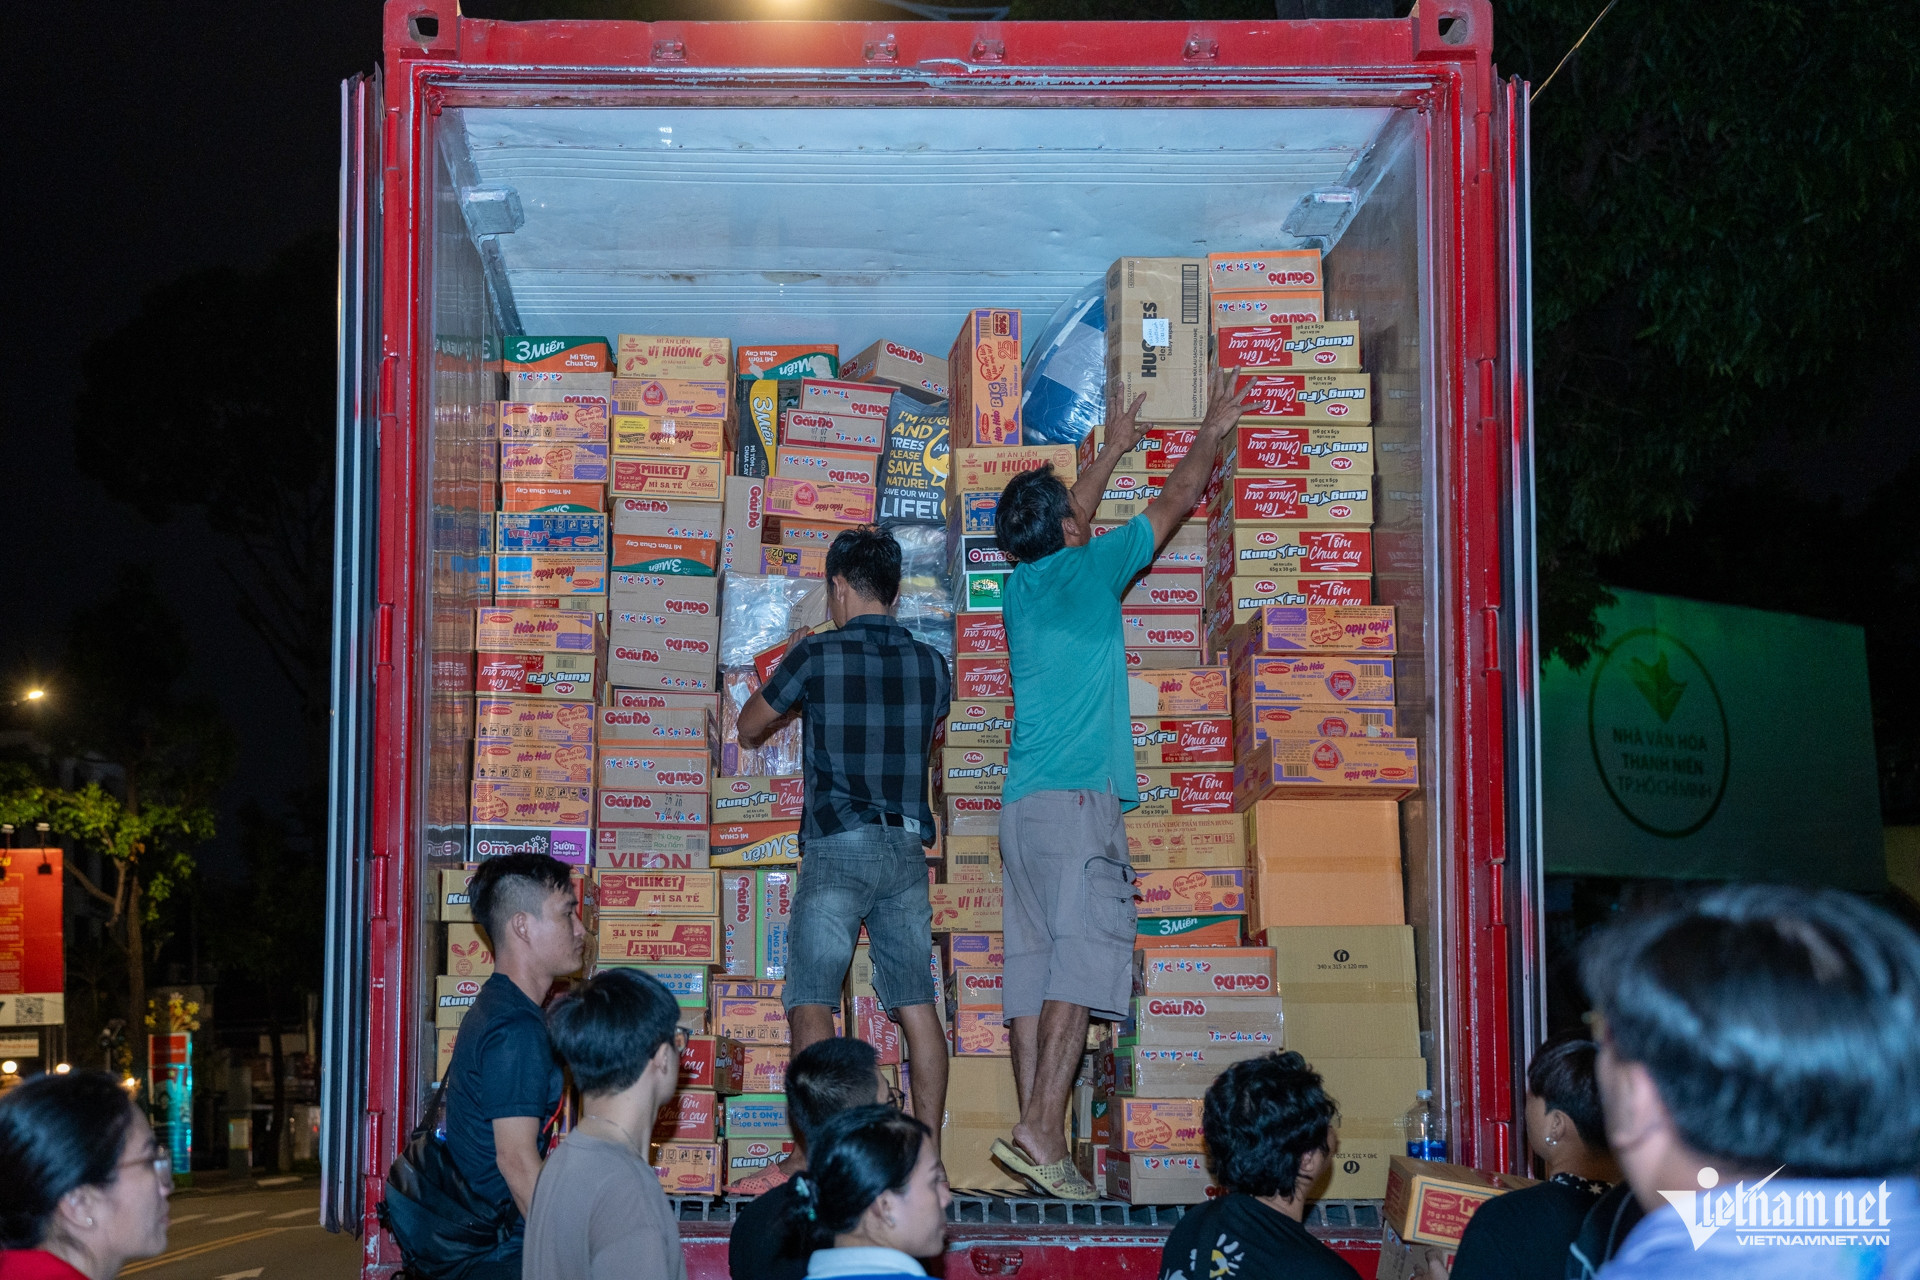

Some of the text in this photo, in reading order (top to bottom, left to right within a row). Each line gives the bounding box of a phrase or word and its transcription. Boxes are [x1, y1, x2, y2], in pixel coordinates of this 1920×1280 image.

[1141, 301, 1158, 378] HUGES
[1285, 335, 1354, 351] Kung Fu
[648, 345, 660, 358] VỊ
[583, 360, 598, 368] Cay
[990, 382, 1003, 408] BIG
[1298, 388, 1365, 402] Kung Fu
[891, 422, 933, 439] AND
[891, 437, 925, 451] TREES
[1301, 442, 1368, 454] Kung Fu
[890, 450, 920, 461] PLEASE
[640, 464, 686, 477] MILIKET
[888, 461, 922, 477] SAVE
[983, 460, 997, 475] VỊ
[660, 481, 671, 489] SA
[886, 476, 928, 489] NATURE!
[884, 488, 900, 496] SAVE
[918, 491, 938, 499] WILD
[1300, 490, 1367, 504] Kung Fu
[880, 500, 938, 519] LIFE!
[1321, 533, 1352, 548] Tôm
[1240, 545, 1307, 560] Kung Fu
[1309, 549, 1362, 562] Chua cay
[1321, 581, 1351, 596] Tôm
[1238, 595, 1306, 609] Kung Fu
[951, 721, 1012, 732] Kung Fu
[1196, 774, 1223, 789] Tôm
[716, 794, 777, 809] Kung Fu
[1181, 788, 1233, 803] Chua cay
[553, 841, 575, 851] Sườn
[609, 853, 691, 869] VIFON
[626, 875, 680, 889] MILIKET
[653, 893, 666, 902] MÌ
[669, 894, 682, 902] SA
[633, 941, 686, 956] MILIKET
[1208, 1030, 1272, 1043] Tôm Chua Cay
